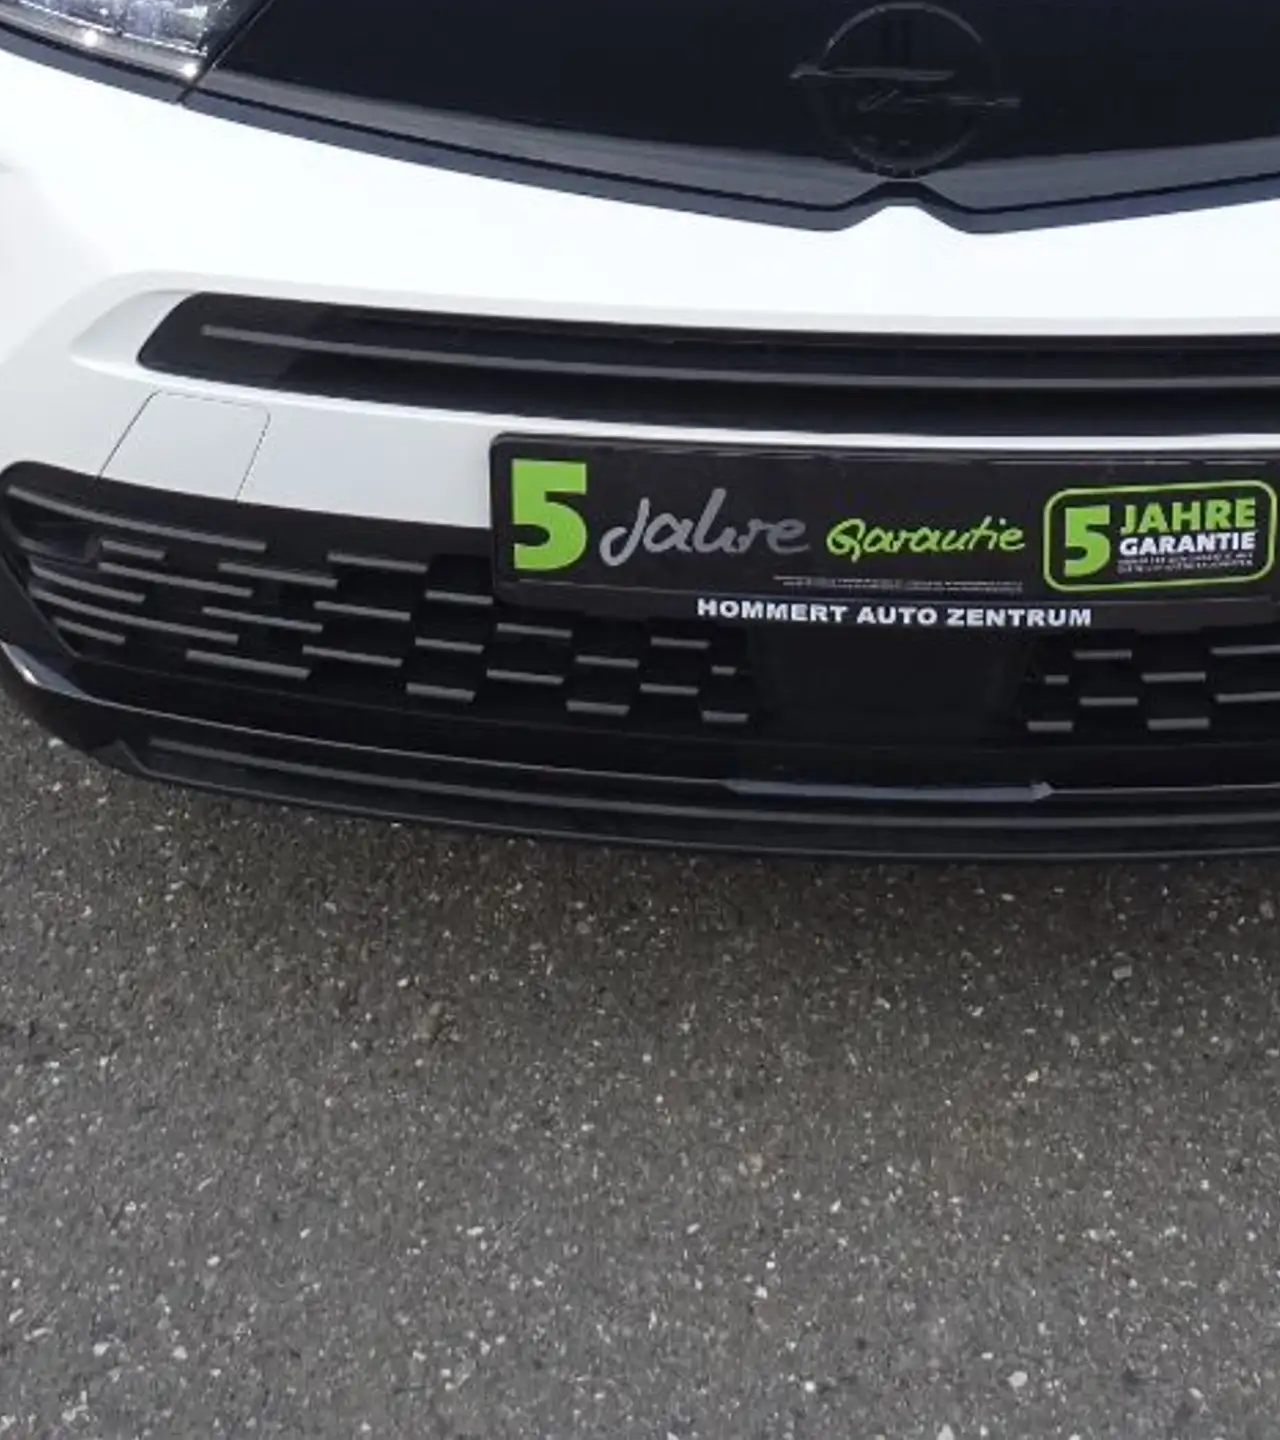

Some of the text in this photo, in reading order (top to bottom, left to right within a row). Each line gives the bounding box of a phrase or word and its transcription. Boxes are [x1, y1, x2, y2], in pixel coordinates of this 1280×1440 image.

[511, 457, 1026, 571] 5 Jahre Garantie
[1119, 497, 1257, 535] JAHRE
[1064, 504, 1111, 578] 5
[1119, 531, 1257, 557] GARANTIE
[696, 597, 1092, 628] HOMMERT AUTO ZENTRUM
